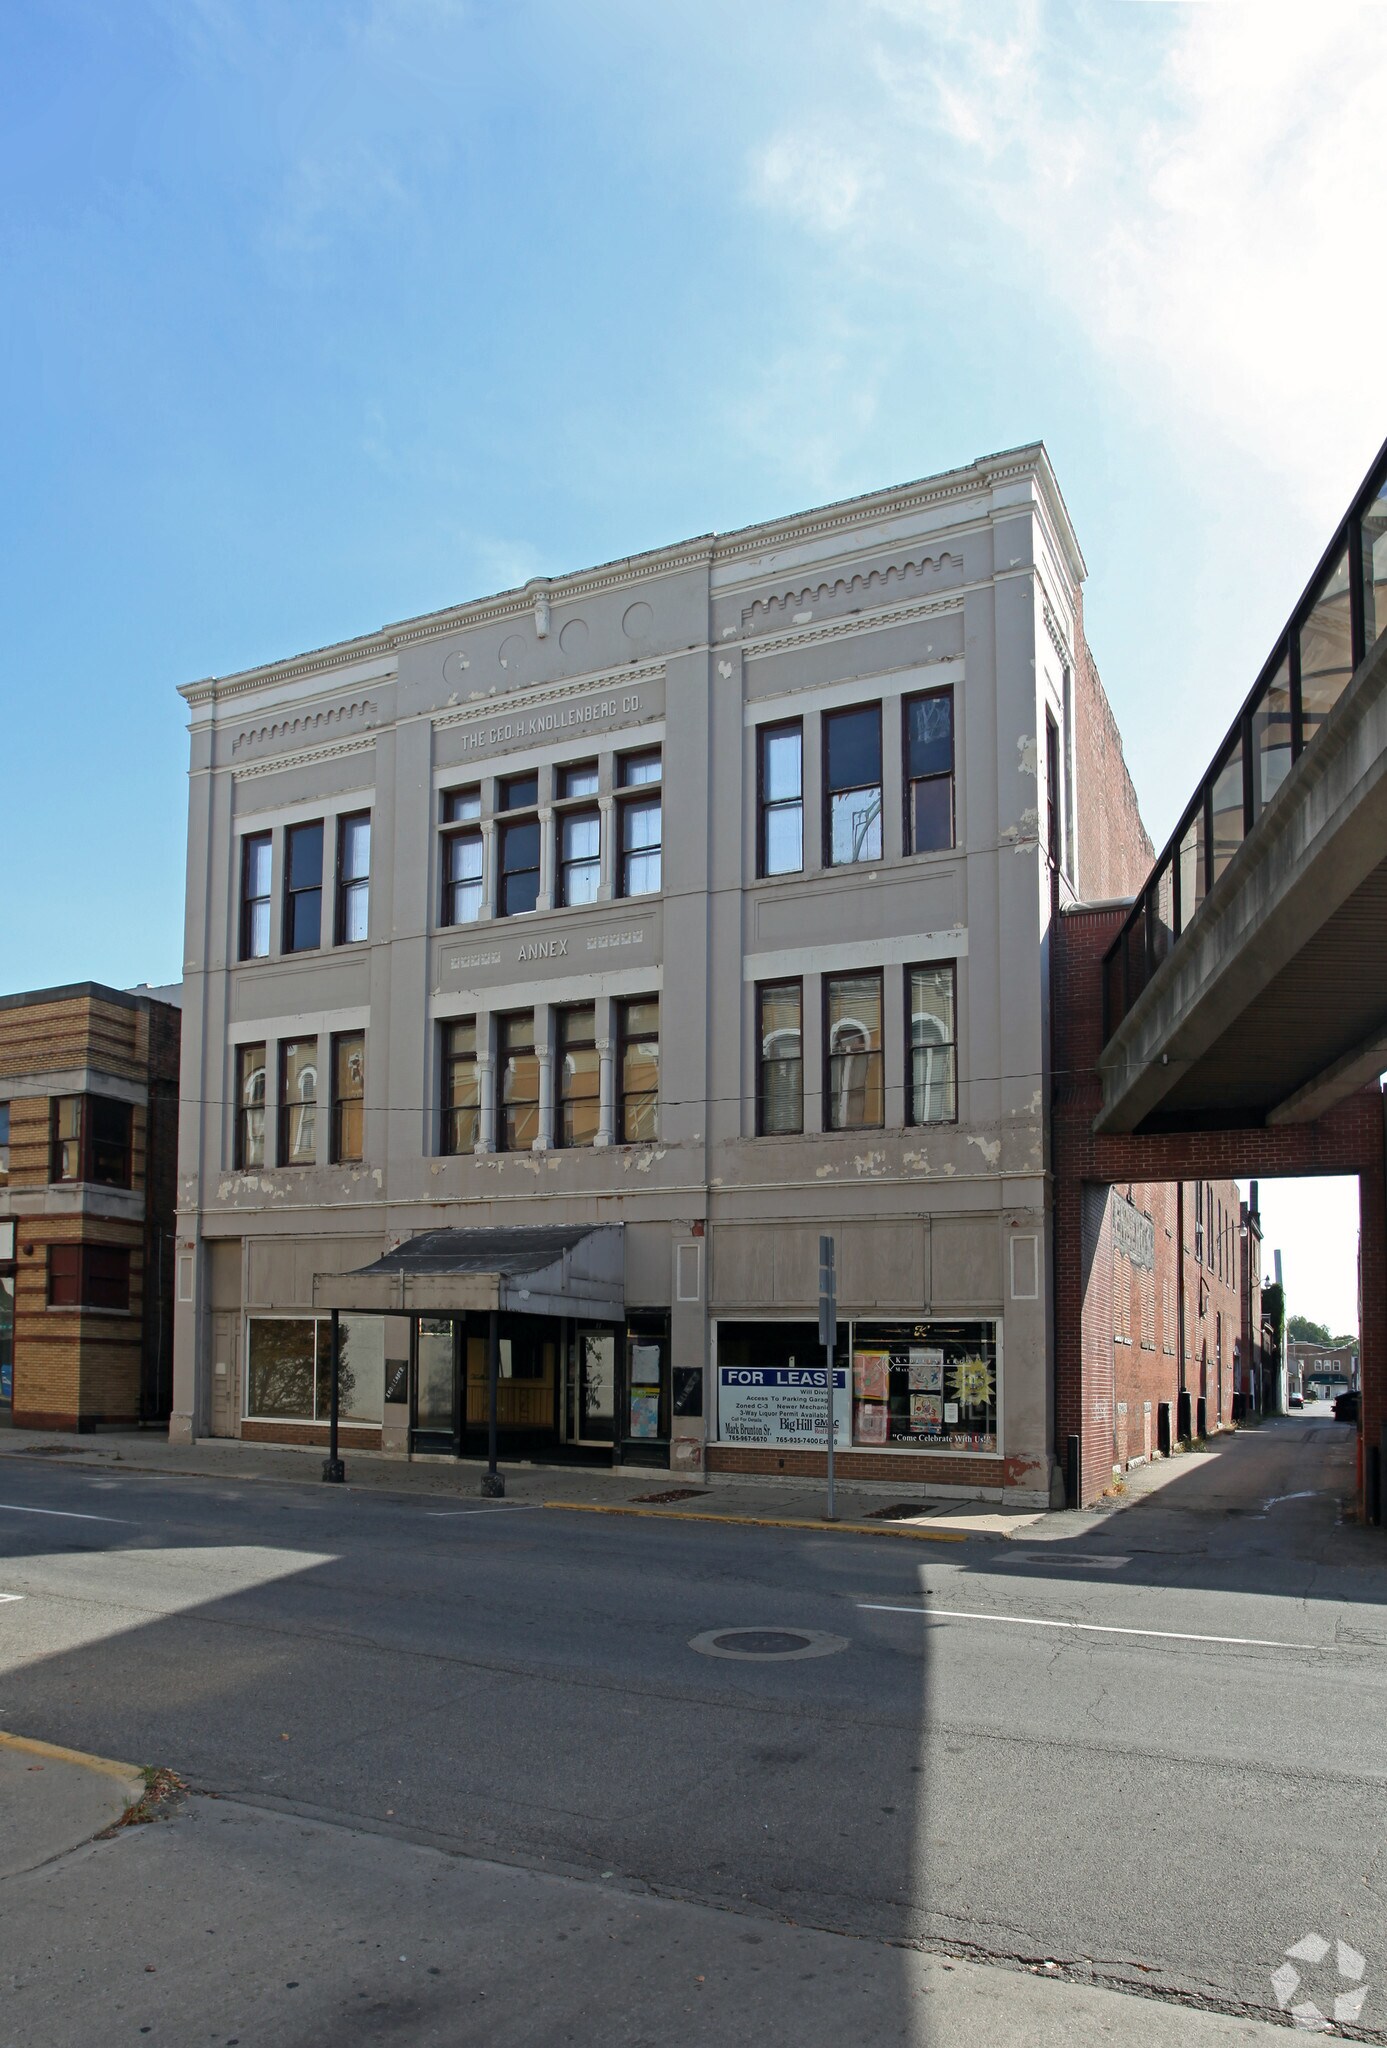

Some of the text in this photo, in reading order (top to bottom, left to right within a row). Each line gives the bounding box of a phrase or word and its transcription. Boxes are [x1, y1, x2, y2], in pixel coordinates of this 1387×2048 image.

[462, 695, 643, 750] THE GEO. H. KNOLLENBERG CO.
[518, 938, 568, 961] ANNEX
[728, 1371, 838, 1386] FOR LEASE
[725, 1422, 772, 1436] Mark Brunton Sr.
[780, 1418, 812, 1433] Big Hill
[814, 1418, 840, 1426] GMC
[892, 1434, 918, 1442] "Come
[918, 1434, 952, 1442] Celebrate
